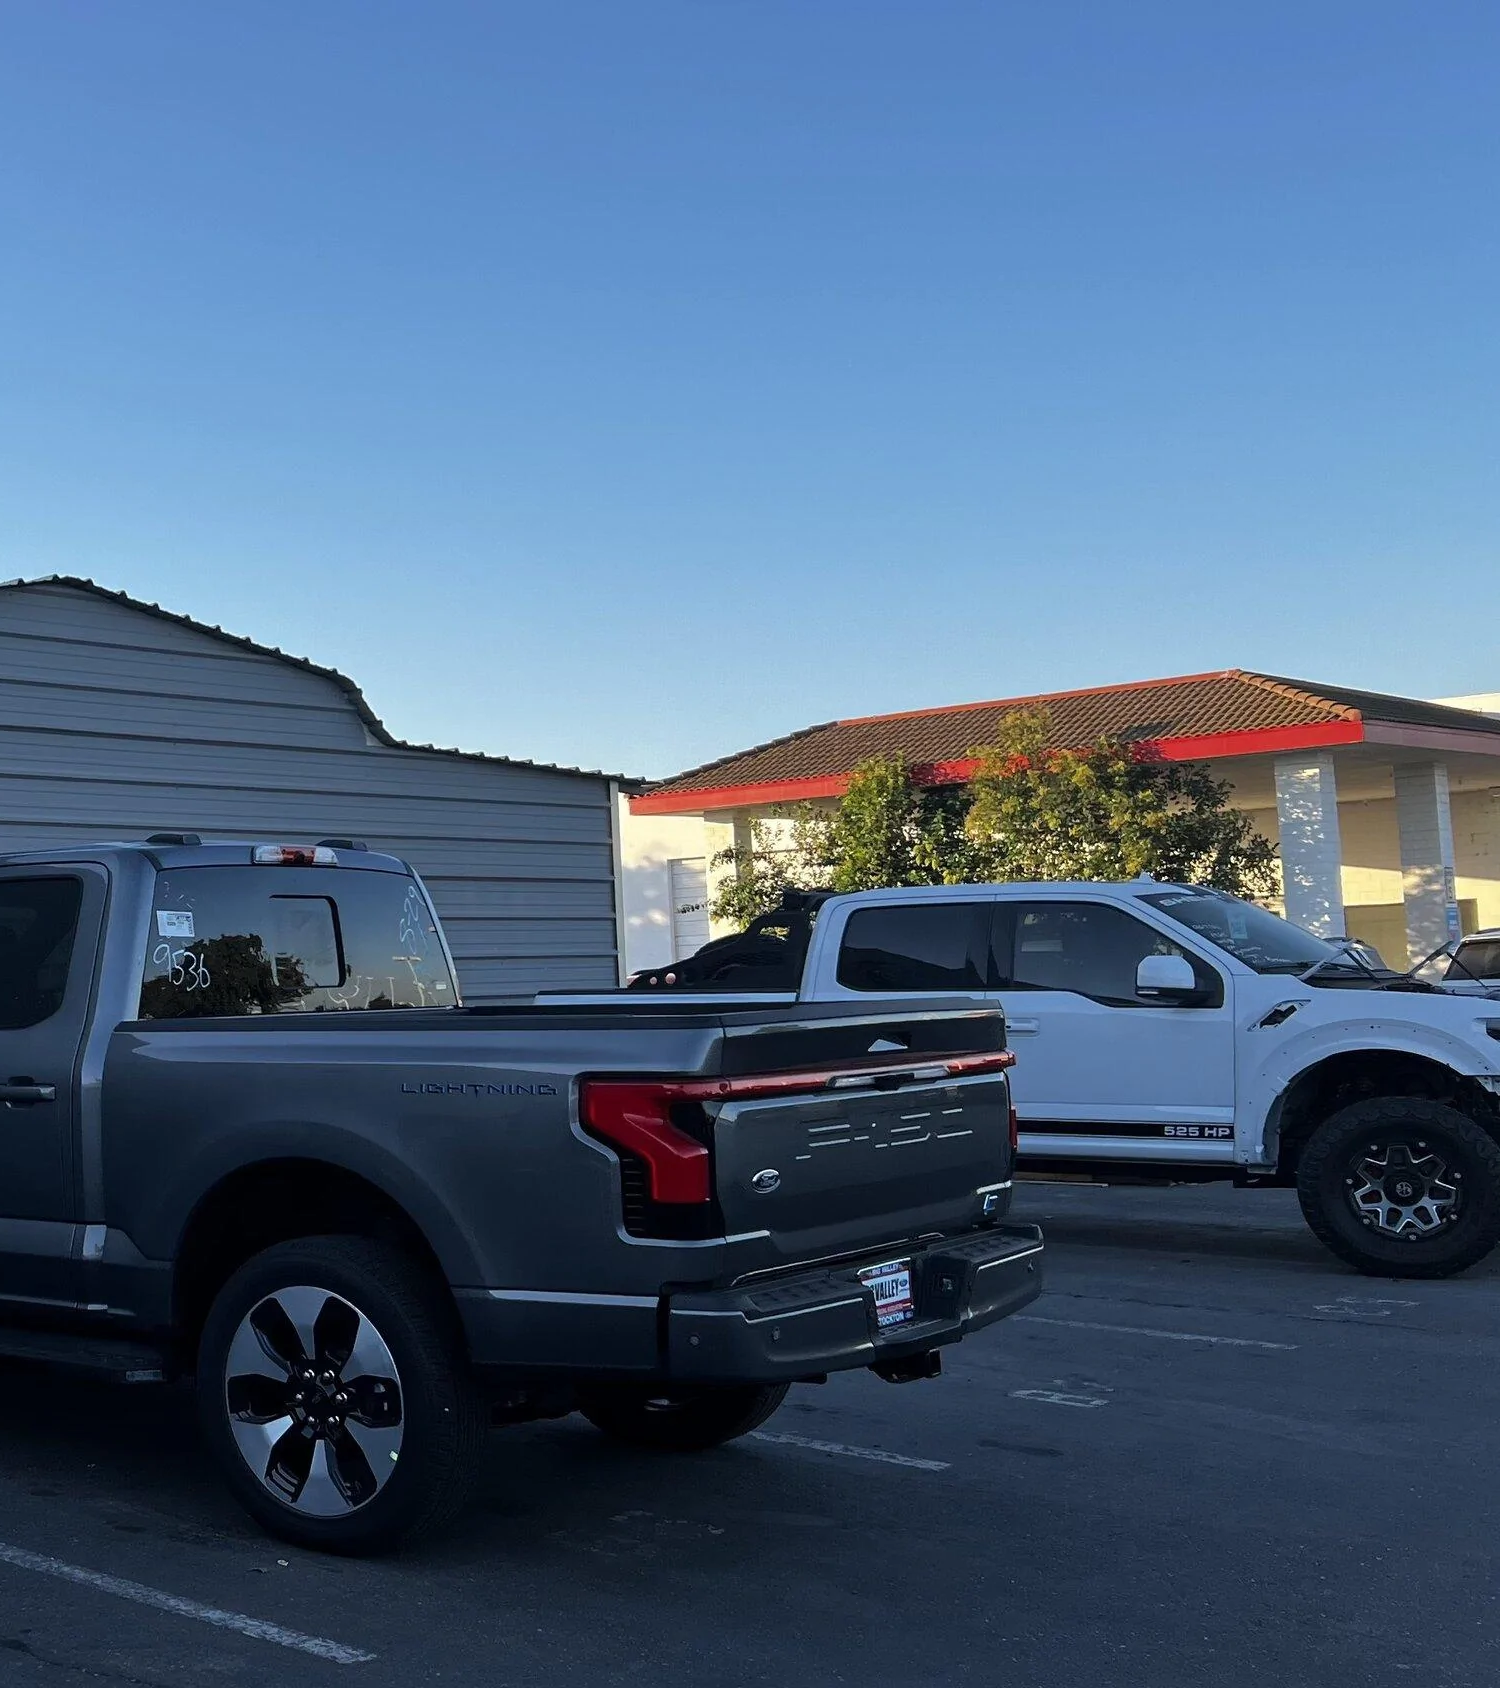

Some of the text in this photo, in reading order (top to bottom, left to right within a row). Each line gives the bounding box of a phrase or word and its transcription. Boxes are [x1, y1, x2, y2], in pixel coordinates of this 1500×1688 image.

[153, 944, 211, 991] 9536
[401, 1083, 559, 1098] LIGHTNING
[1164, 1126, 1231, 1137] 525 HP
[878, 1311, 905, 1327] TOCKTON
